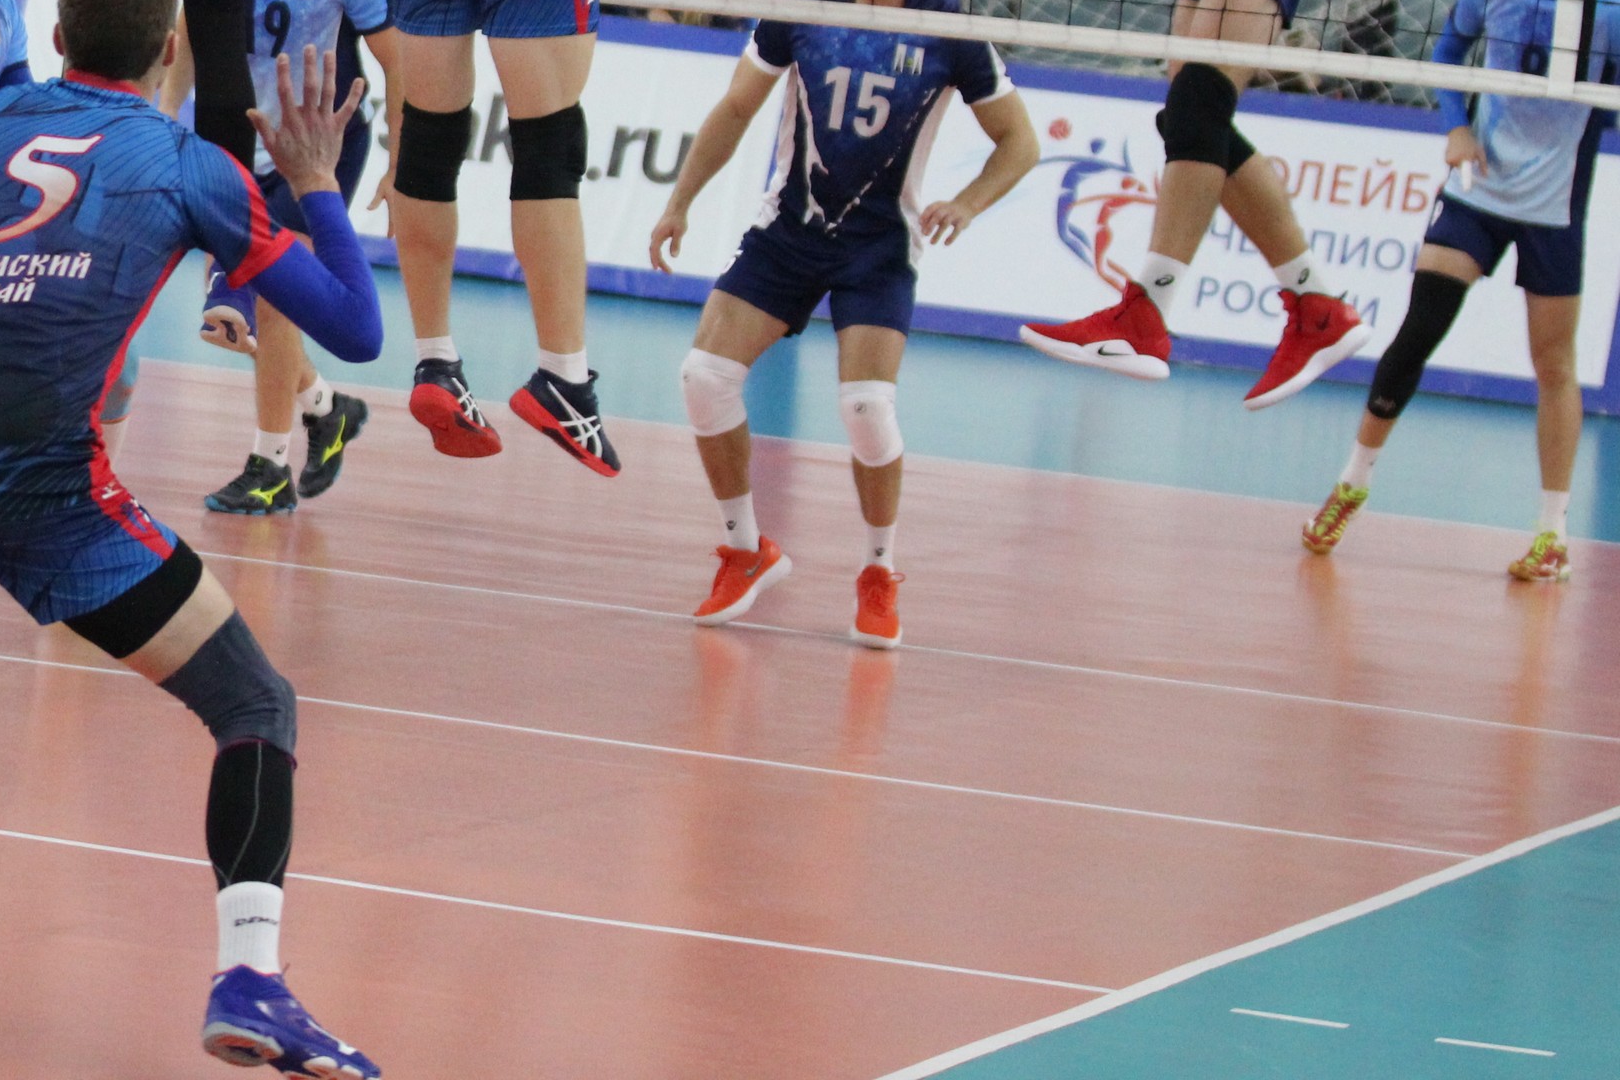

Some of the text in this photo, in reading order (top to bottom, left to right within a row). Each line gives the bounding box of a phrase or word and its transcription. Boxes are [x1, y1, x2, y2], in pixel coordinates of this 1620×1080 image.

[824, 66, 896, 138] 15
[1267, 155, 1430, 214] ОЛЕЙБ
[1210, 216, 1418, 274] ЧЕПИО
[1196, 277, 1380, 328] РОСИ
